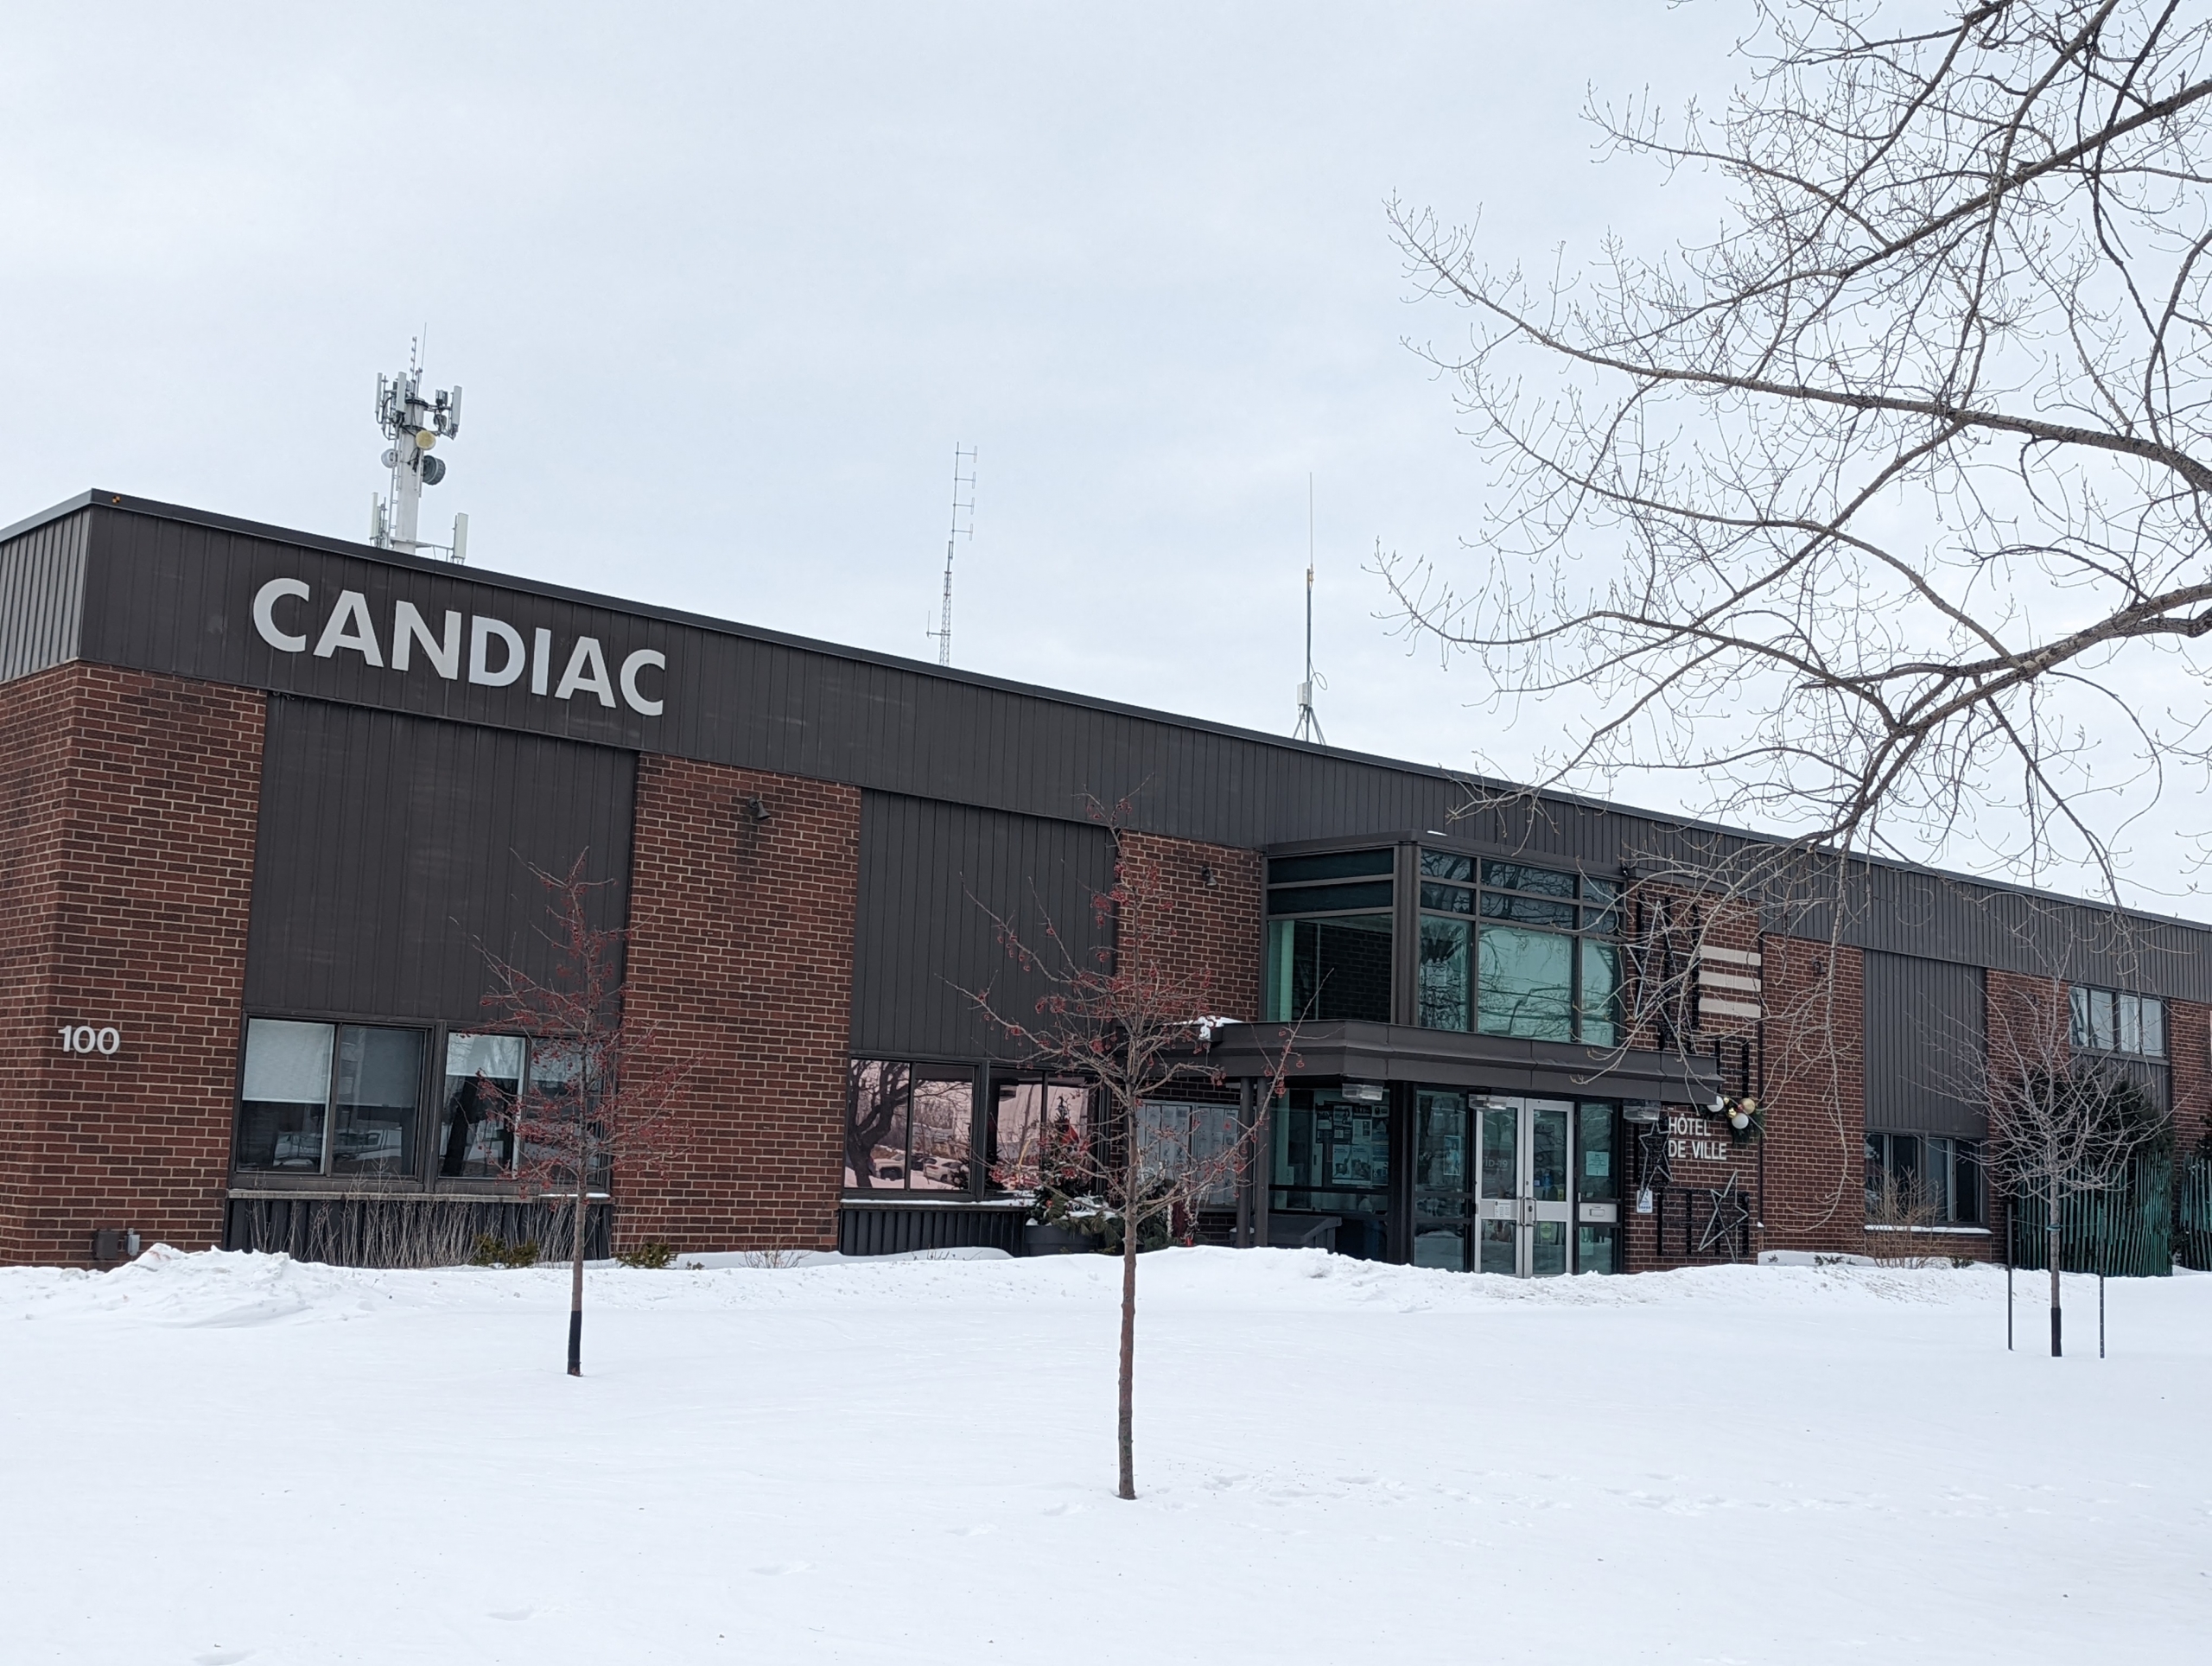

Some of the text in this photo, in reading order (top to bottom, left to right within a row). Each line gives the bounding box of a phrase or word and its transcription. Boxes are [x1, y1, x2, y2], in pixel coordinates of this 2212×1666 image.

[252, 577, 666, 716] CANDIAC
[58, 1025, 120, 1054] 100
[1669, 1113, 1711, 1136] HÔTEL
[1669, 1140, 1726, 1160] DE VILLE
